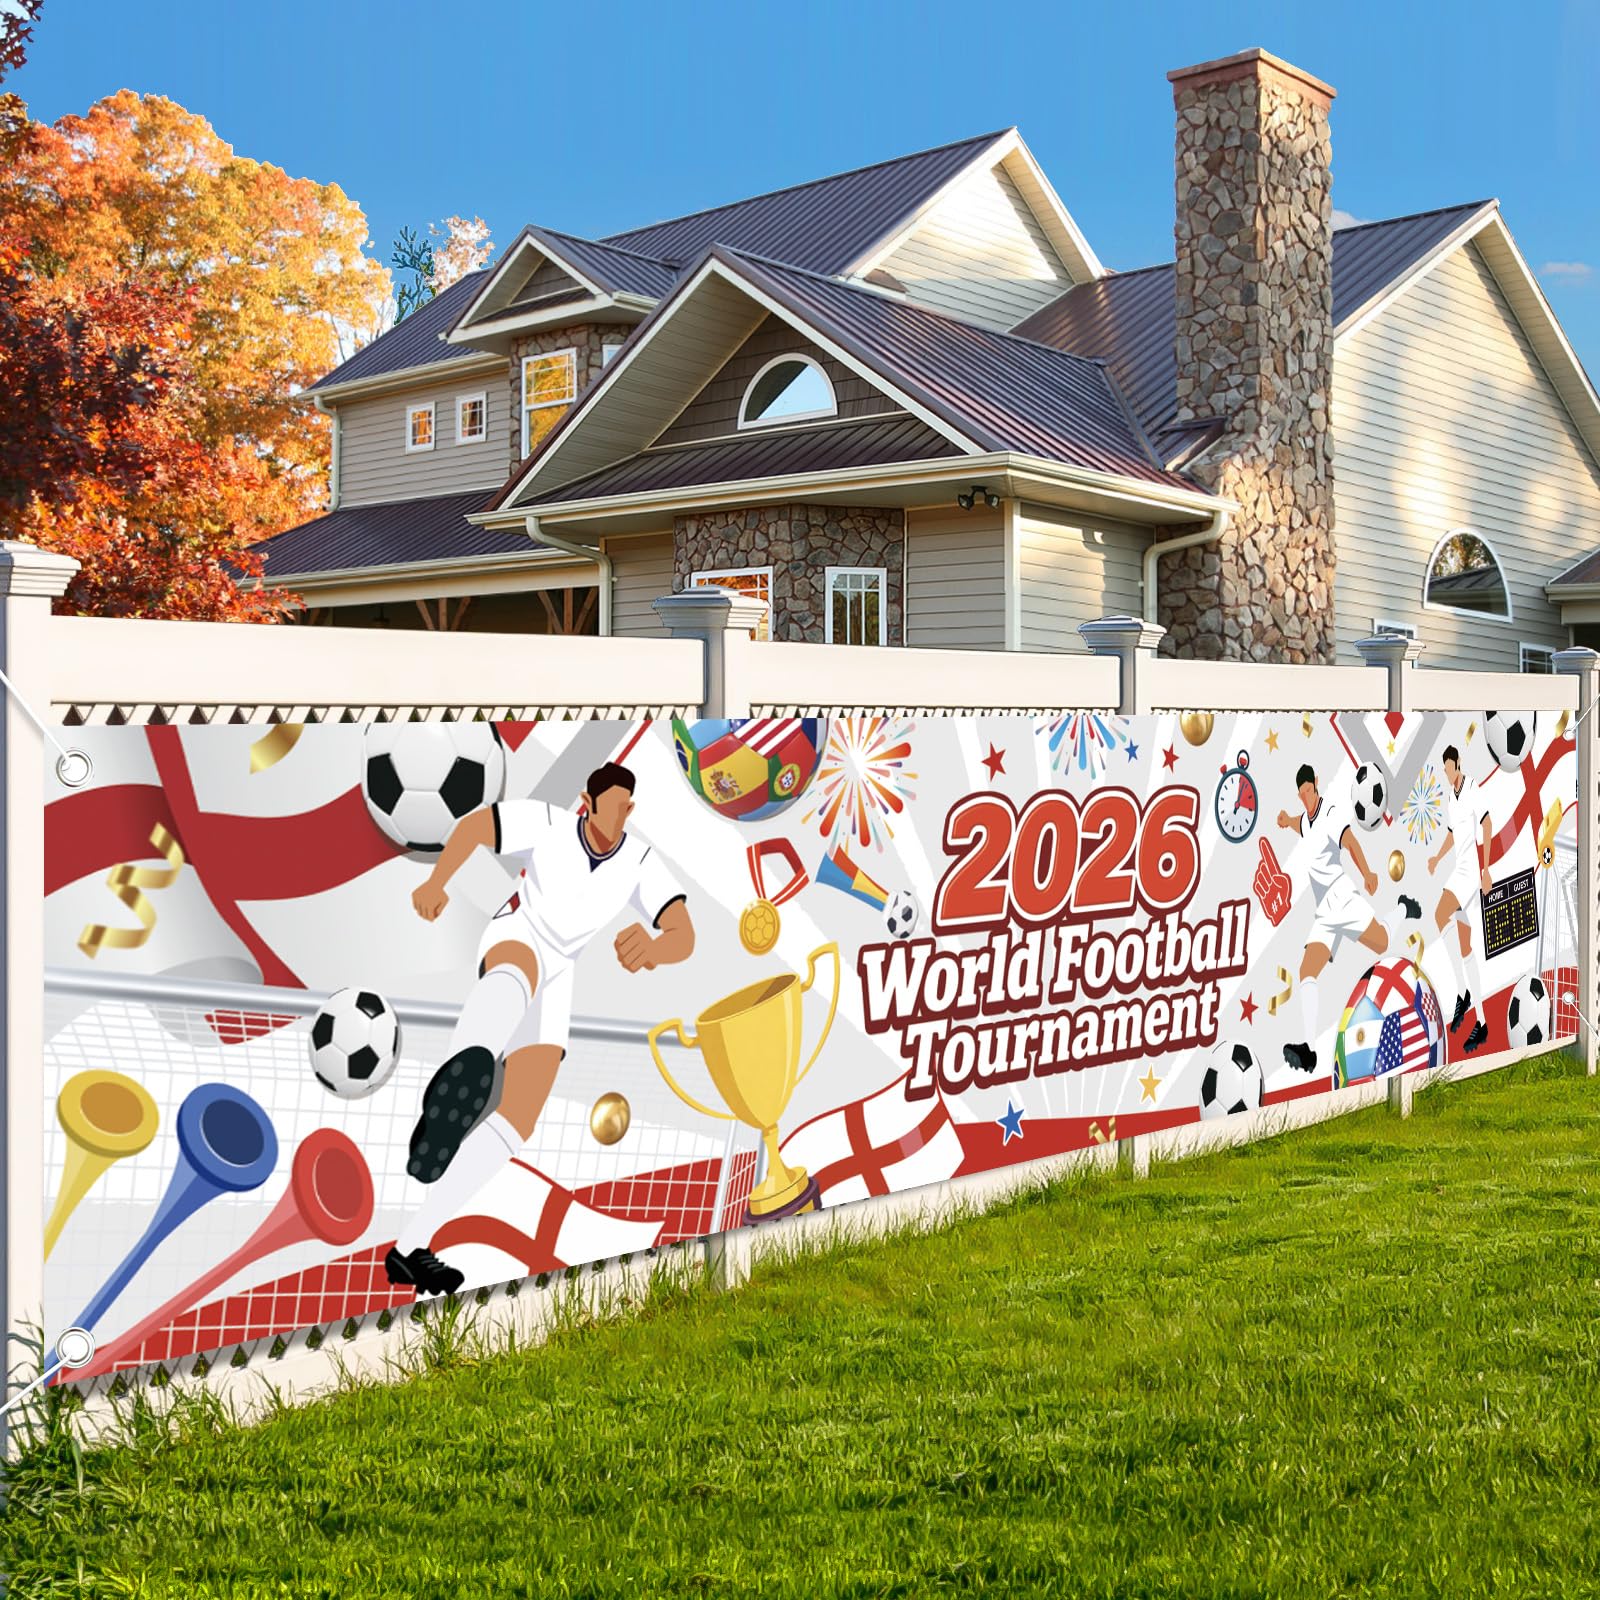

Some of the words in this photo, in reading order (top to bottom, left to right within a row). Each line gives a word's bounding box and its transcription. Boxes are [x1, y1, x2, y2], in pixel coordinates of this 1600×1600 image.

[937, 790, 1198, 922] 2026
[1271, 892, 1283, 914] #1
[1488, 889, 1504, 903] HOME
[1513, 878, 1529, 892] GUEST
[862, 930, 1042, 1021] World
[1053, 903, 1248, 993] Football
[906, 981, 1217, 1089] Tournament
